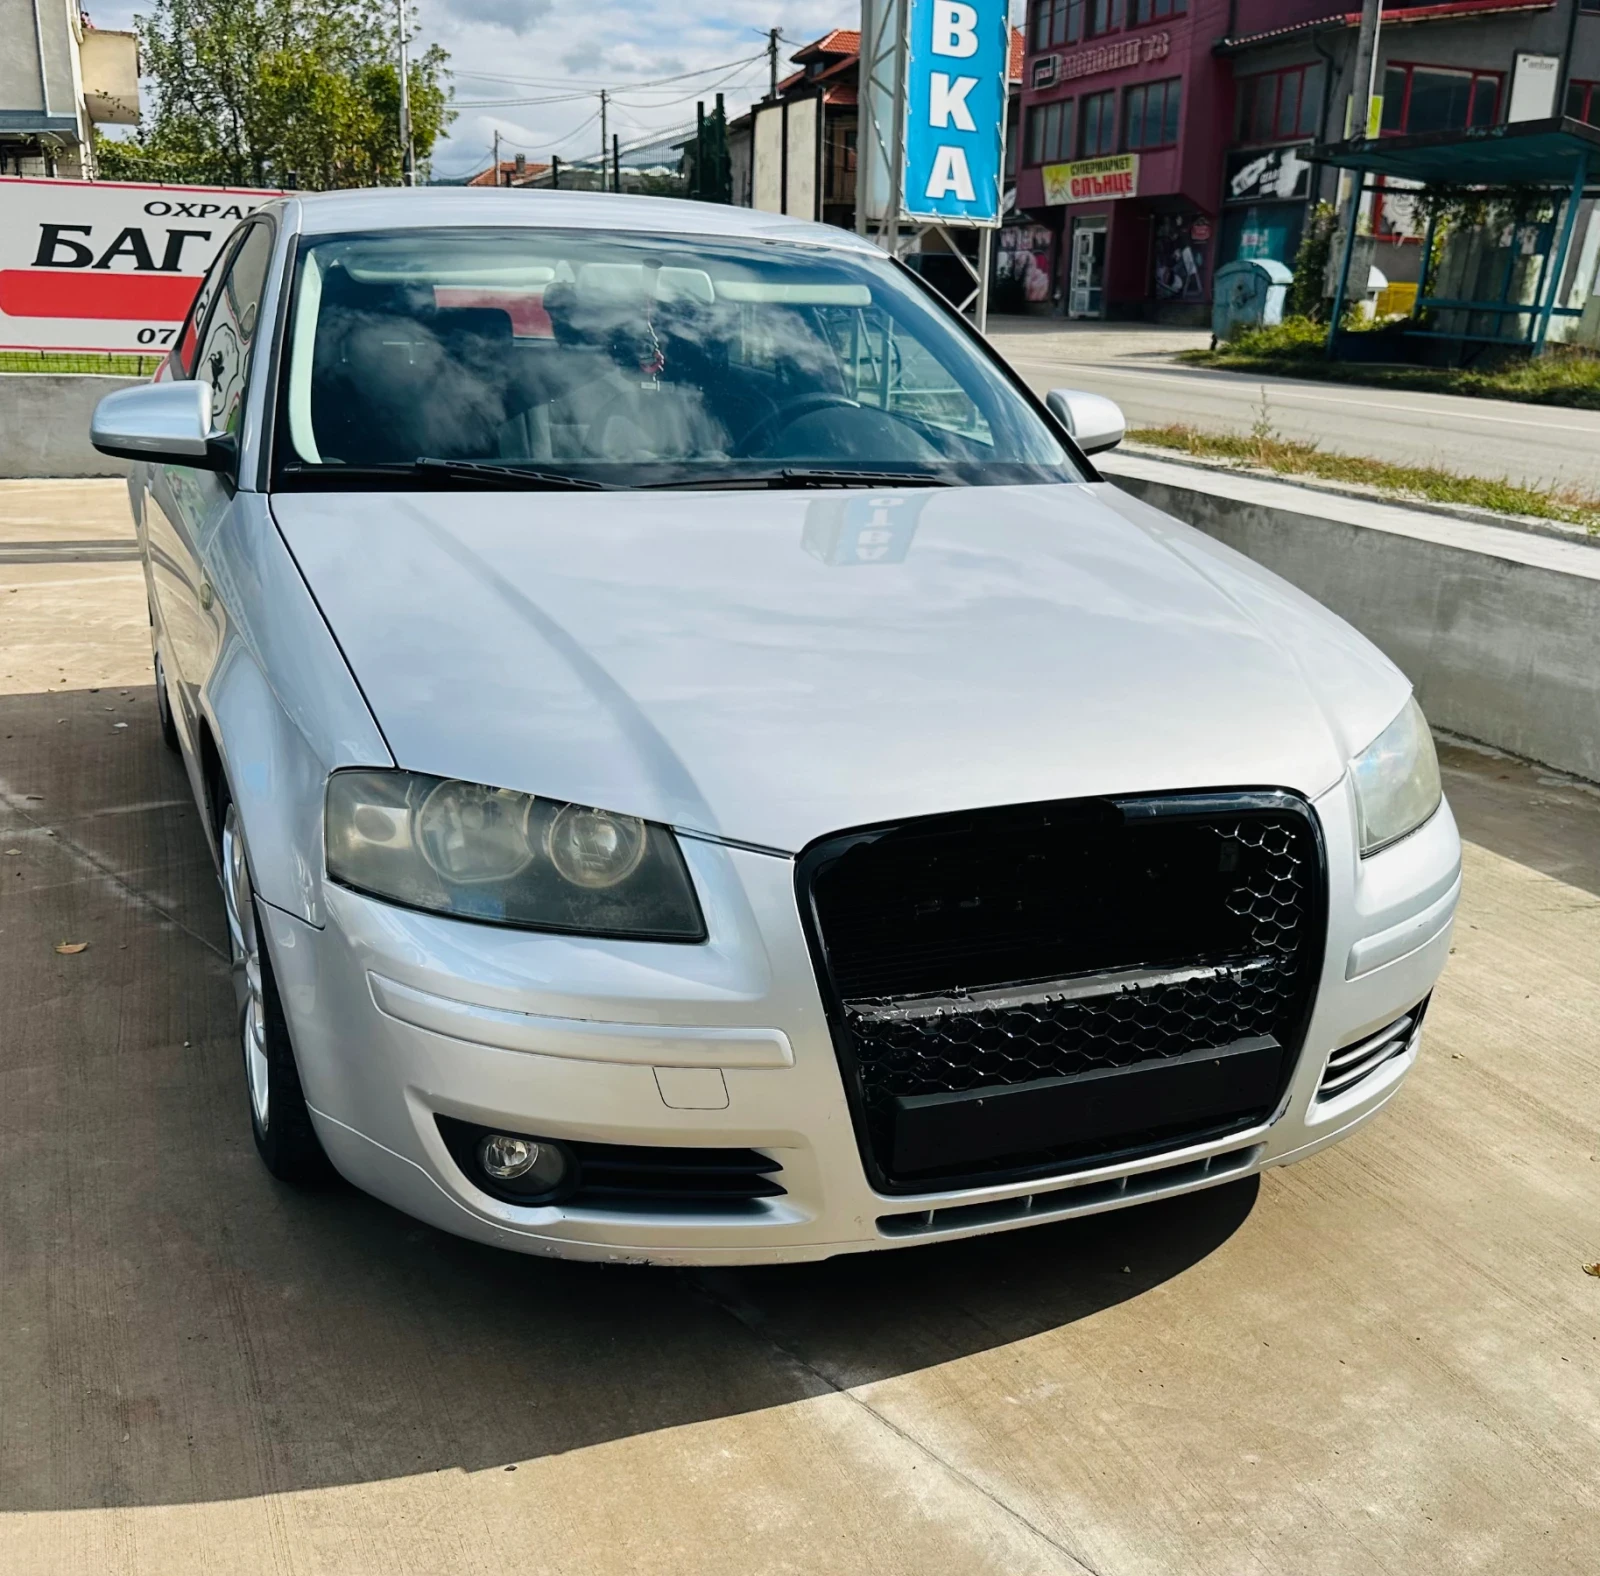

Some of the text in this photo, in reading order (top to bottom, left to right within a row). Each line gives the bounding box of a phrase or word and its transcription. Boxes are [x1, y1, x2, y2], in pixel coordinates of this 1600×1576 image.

[1070, 157, 1130, 176] СУПЕРМАРКЕТ
[1070, 172, 1133, 198] СЛЪНЦЕ
[143, 201, 256, 220] ОХРА
[31, 223, 213, 273] БАГ
